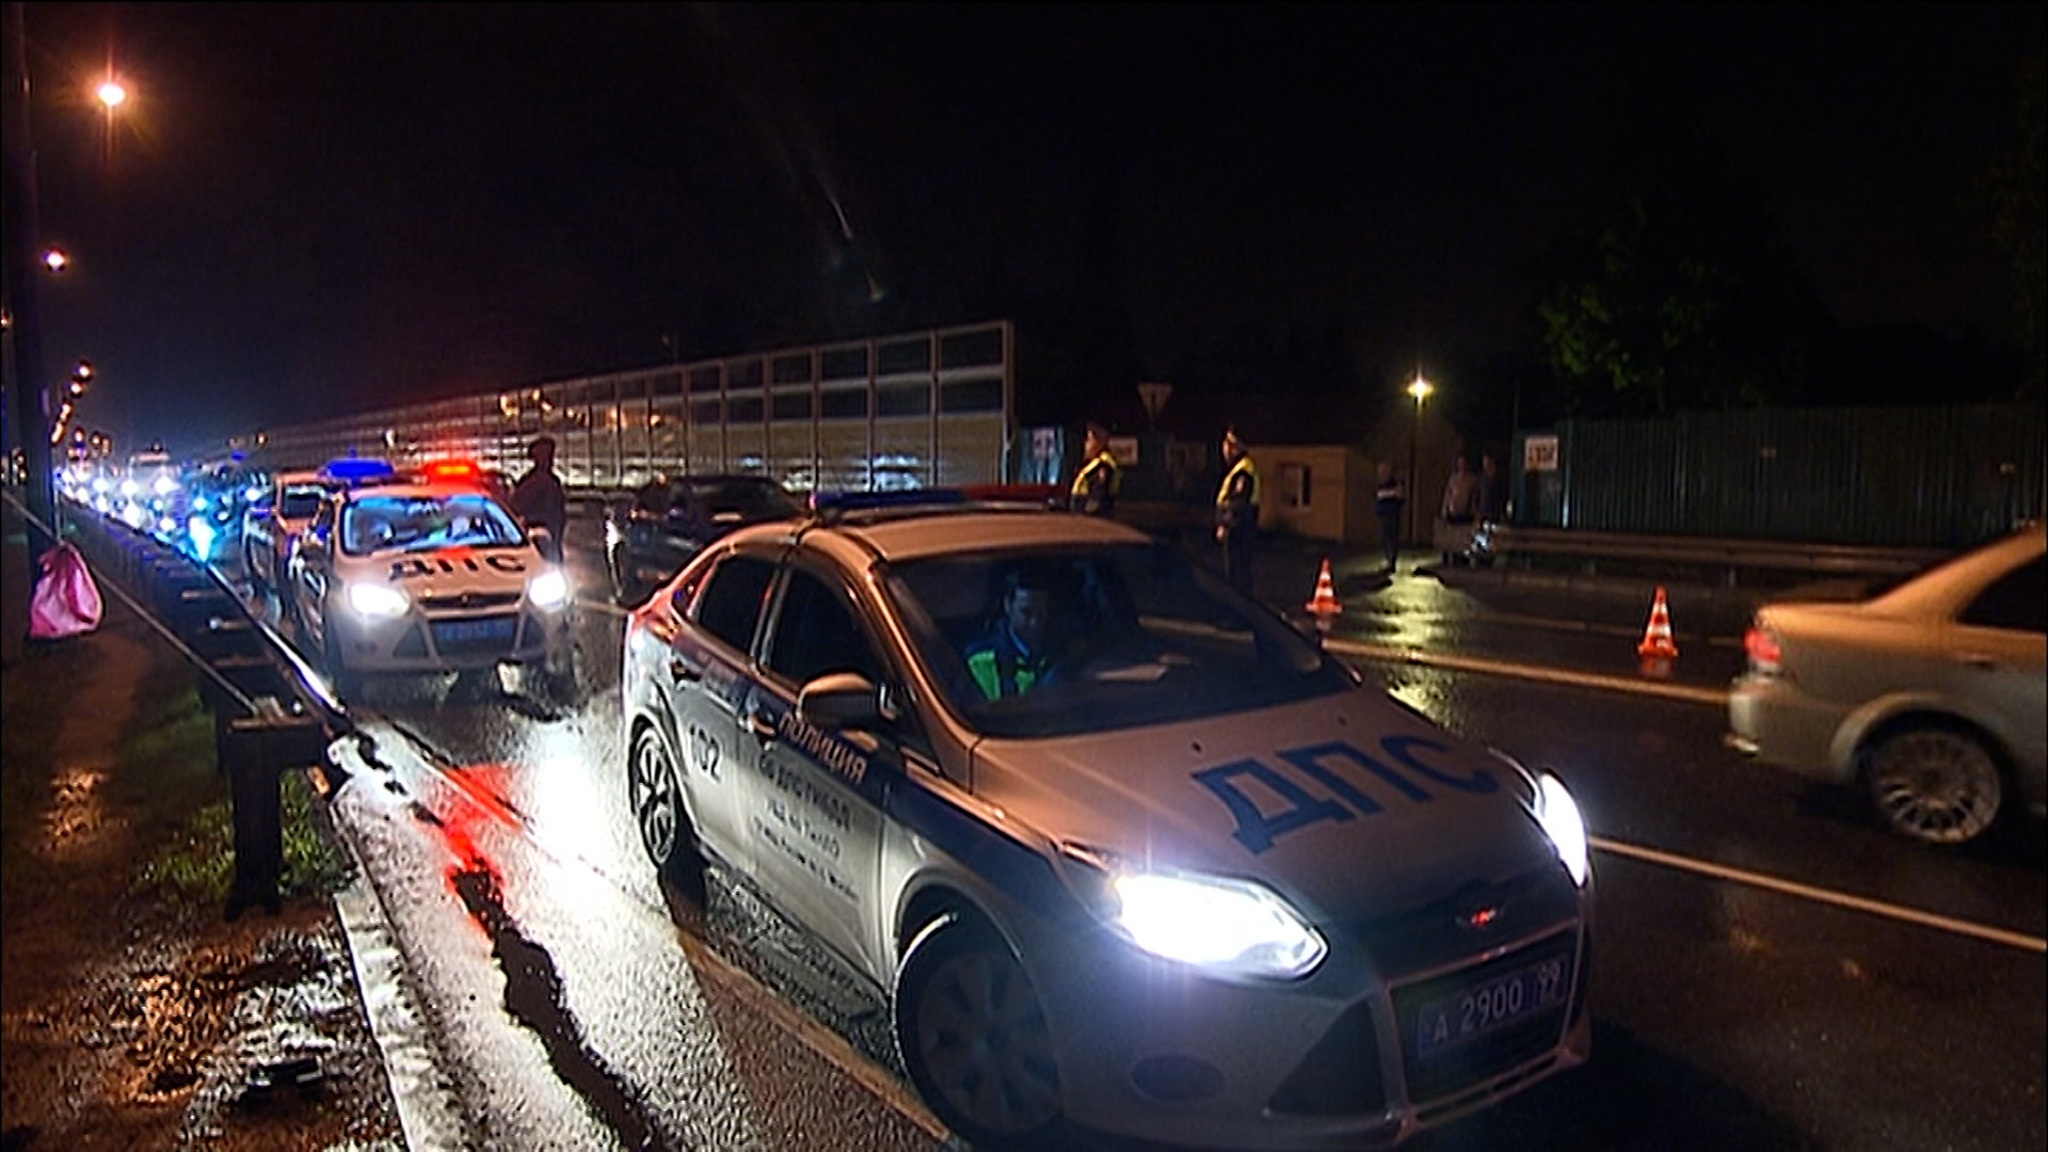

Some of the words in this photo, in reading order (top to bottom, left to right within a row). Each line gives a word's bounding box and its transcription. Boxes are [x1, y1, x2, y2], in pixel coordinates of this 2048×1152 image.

[389, 556, 526, 581] ДПС
[778, 710, 868, 785] ПОЛИЦИЯ
[1191, 734, 1500, 857] ДПС
[1460, 979, 1524, 1034] 2900
[1537, 961, 1562, 1002] 99
